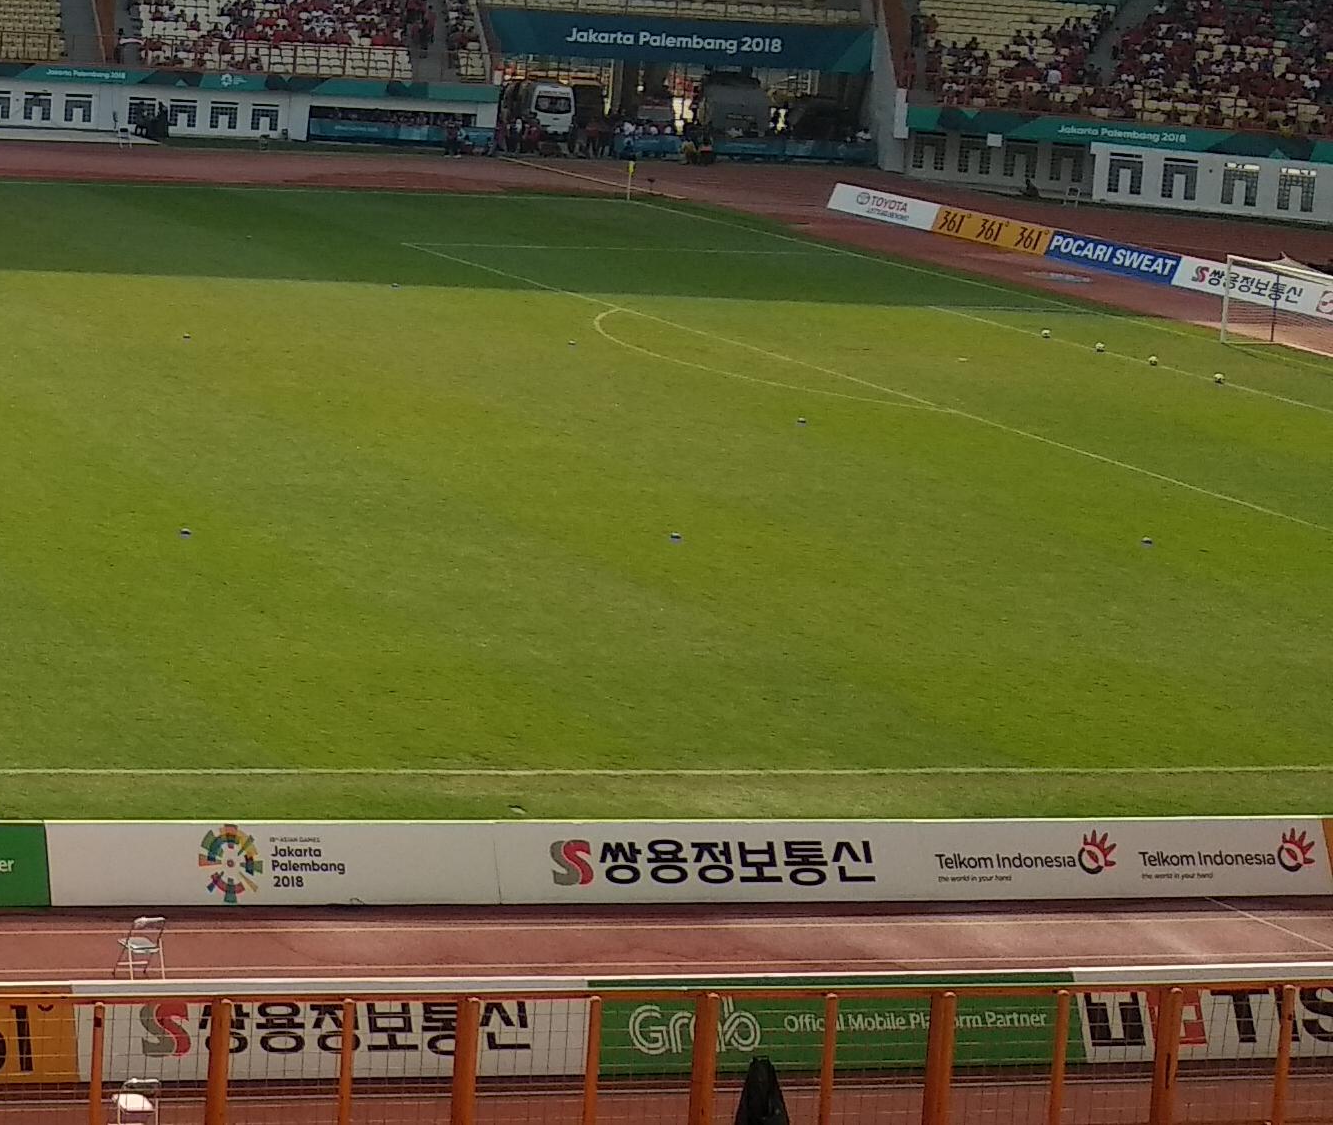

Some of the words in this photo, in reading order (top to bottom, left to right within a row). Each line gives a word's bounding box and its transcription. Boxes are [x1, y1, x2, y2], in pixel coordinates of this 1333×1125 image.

[565, 27, 635, 45] Jakarta
[639, 31, 738, 54] Palembang
[740, 36, 782, 53] 2018
[1057, 125, 1098, 135] Jakarta
[1100, 127, 1160, 142] Palembang
[1161, 132, 1187, 142] 2018
[870, 195, 908, 213] TOYOTA
[1049, 234, 1114, 262] POCARI
[1112, 248, 1177, 276] SWEAT
[271, 845, 322, 857] Jakarta
[1138, 851, 1196, 867] Telkom
[1197, 850, 1276, 866] Indonesia
[271, 860, 346, 875] Palembang
[599, 838, 876, 885] 쌍용정보통신
[935, 853, 993, 869] Telkom
[996, 852, 1077, 869] Indonesia
[273, 875, 304, 887] 2018
[848, 1011, 906, 1031] Mobile
[986, 1011, 1048, 1028] Partner
